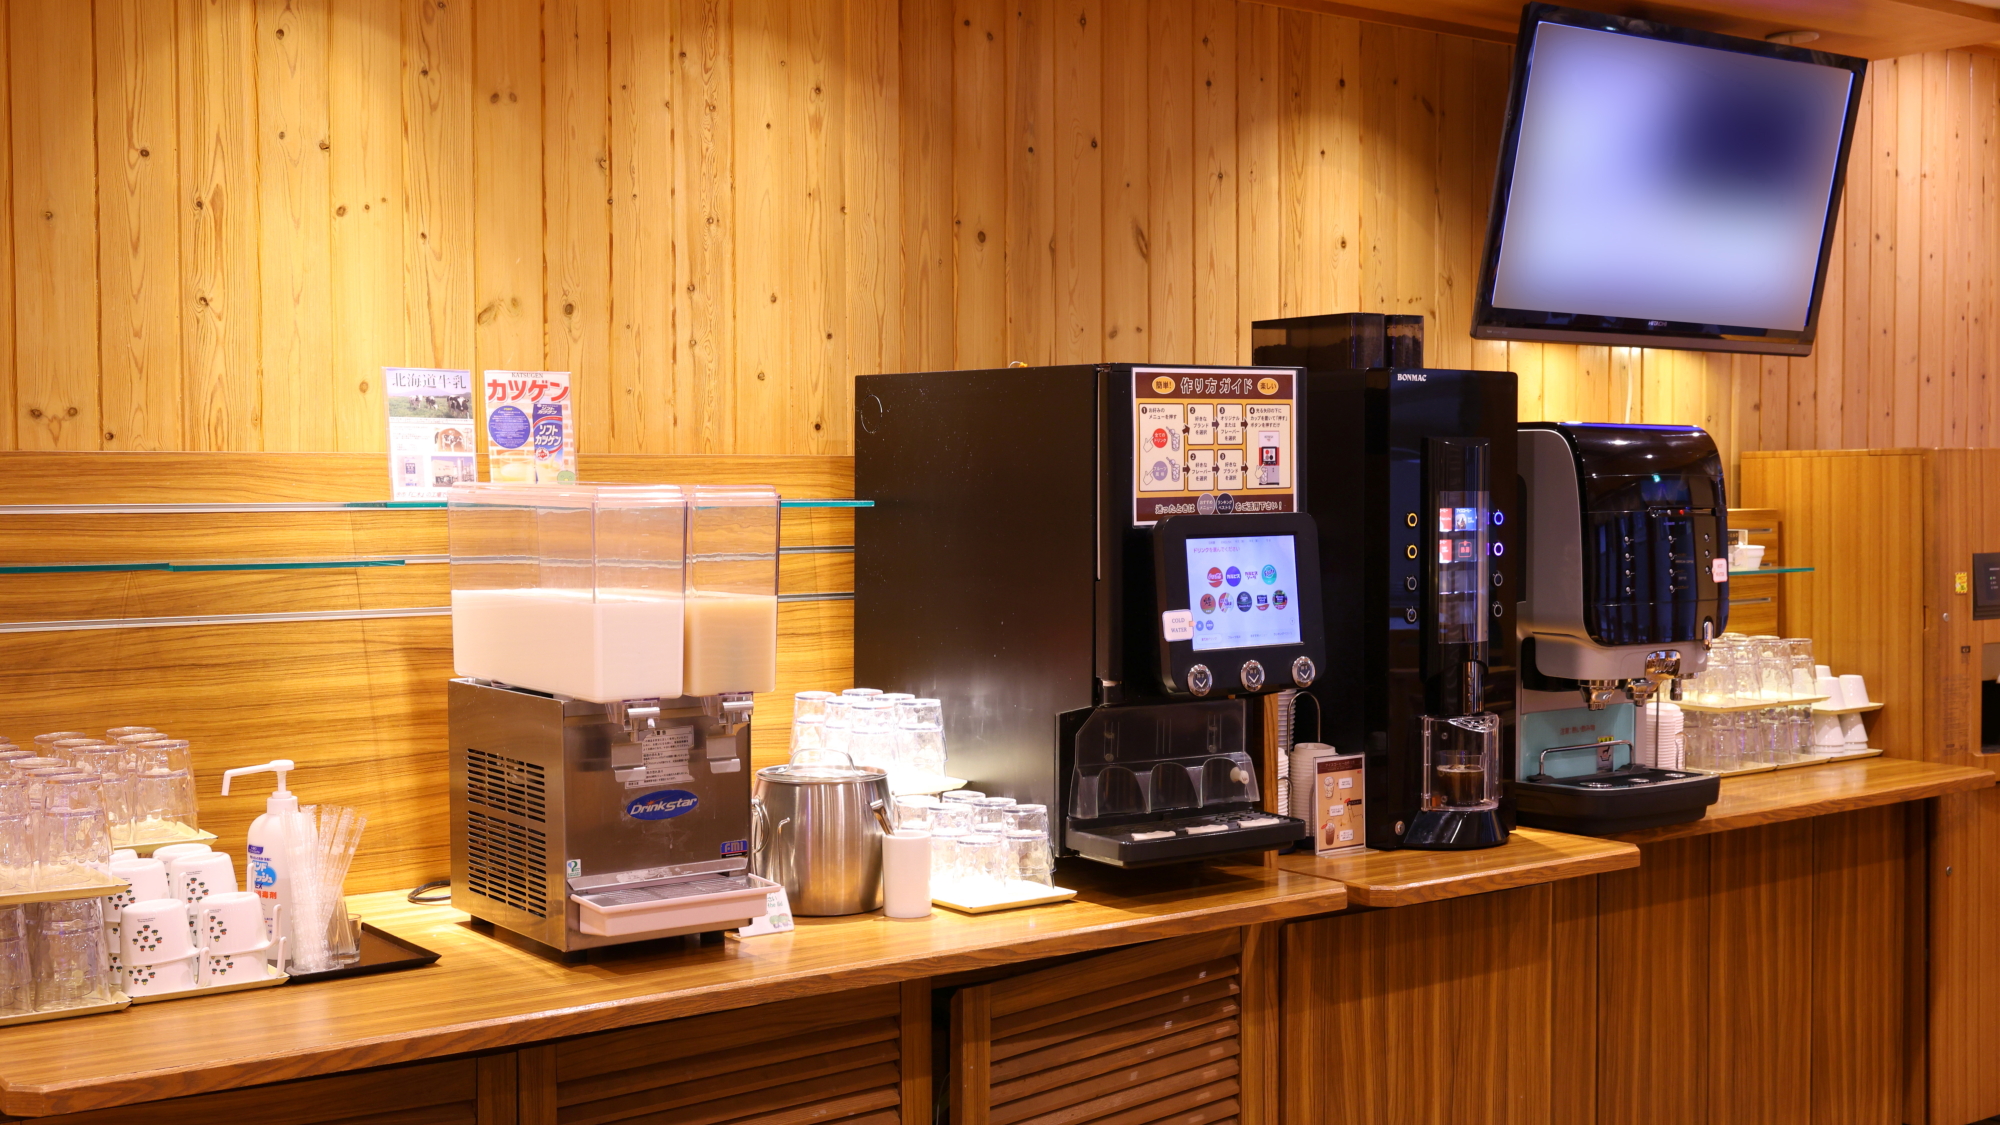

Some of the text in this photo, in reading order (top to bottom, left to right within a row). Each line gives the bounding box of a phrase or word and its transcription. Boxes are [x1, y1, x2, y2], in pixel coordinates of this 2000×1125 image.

[392, 373, 467, 389] 北海道牛乳
[1397, 373, 1427, 382] BONMAC
[487, 379, 569, 402] カツゲン
[1180, 377, 1253, 394] 作り方ガイド
[539, 425, 558, 435] ソフト
[534, 435, 562, 446] カツゲン
[1155, 504, 1195, 515] 迷ったときは
[630, 798, 697, 815] Drinkstar
[724, 841, 744, 853] FMI
